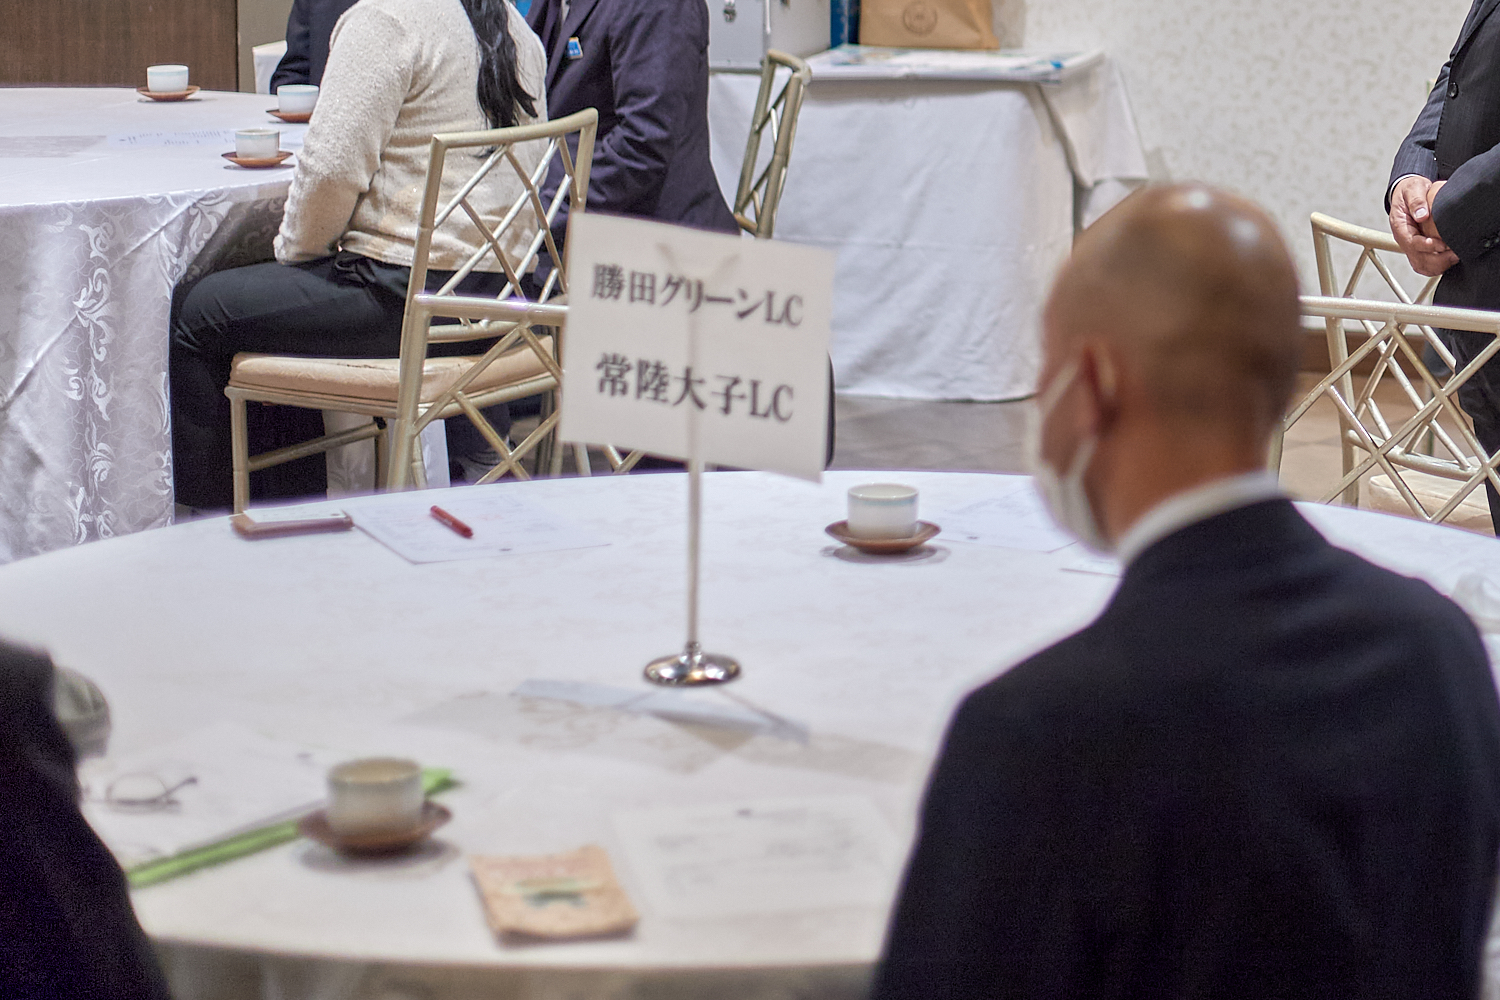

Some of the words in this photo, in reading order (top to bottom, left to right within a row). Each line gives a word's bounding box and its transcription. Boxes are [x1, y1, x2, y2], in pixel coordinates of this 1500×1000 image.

[591, 262, 804, 328] 勝田グリーンLC
[595, 352, 795, 423] 常陸大子LC
